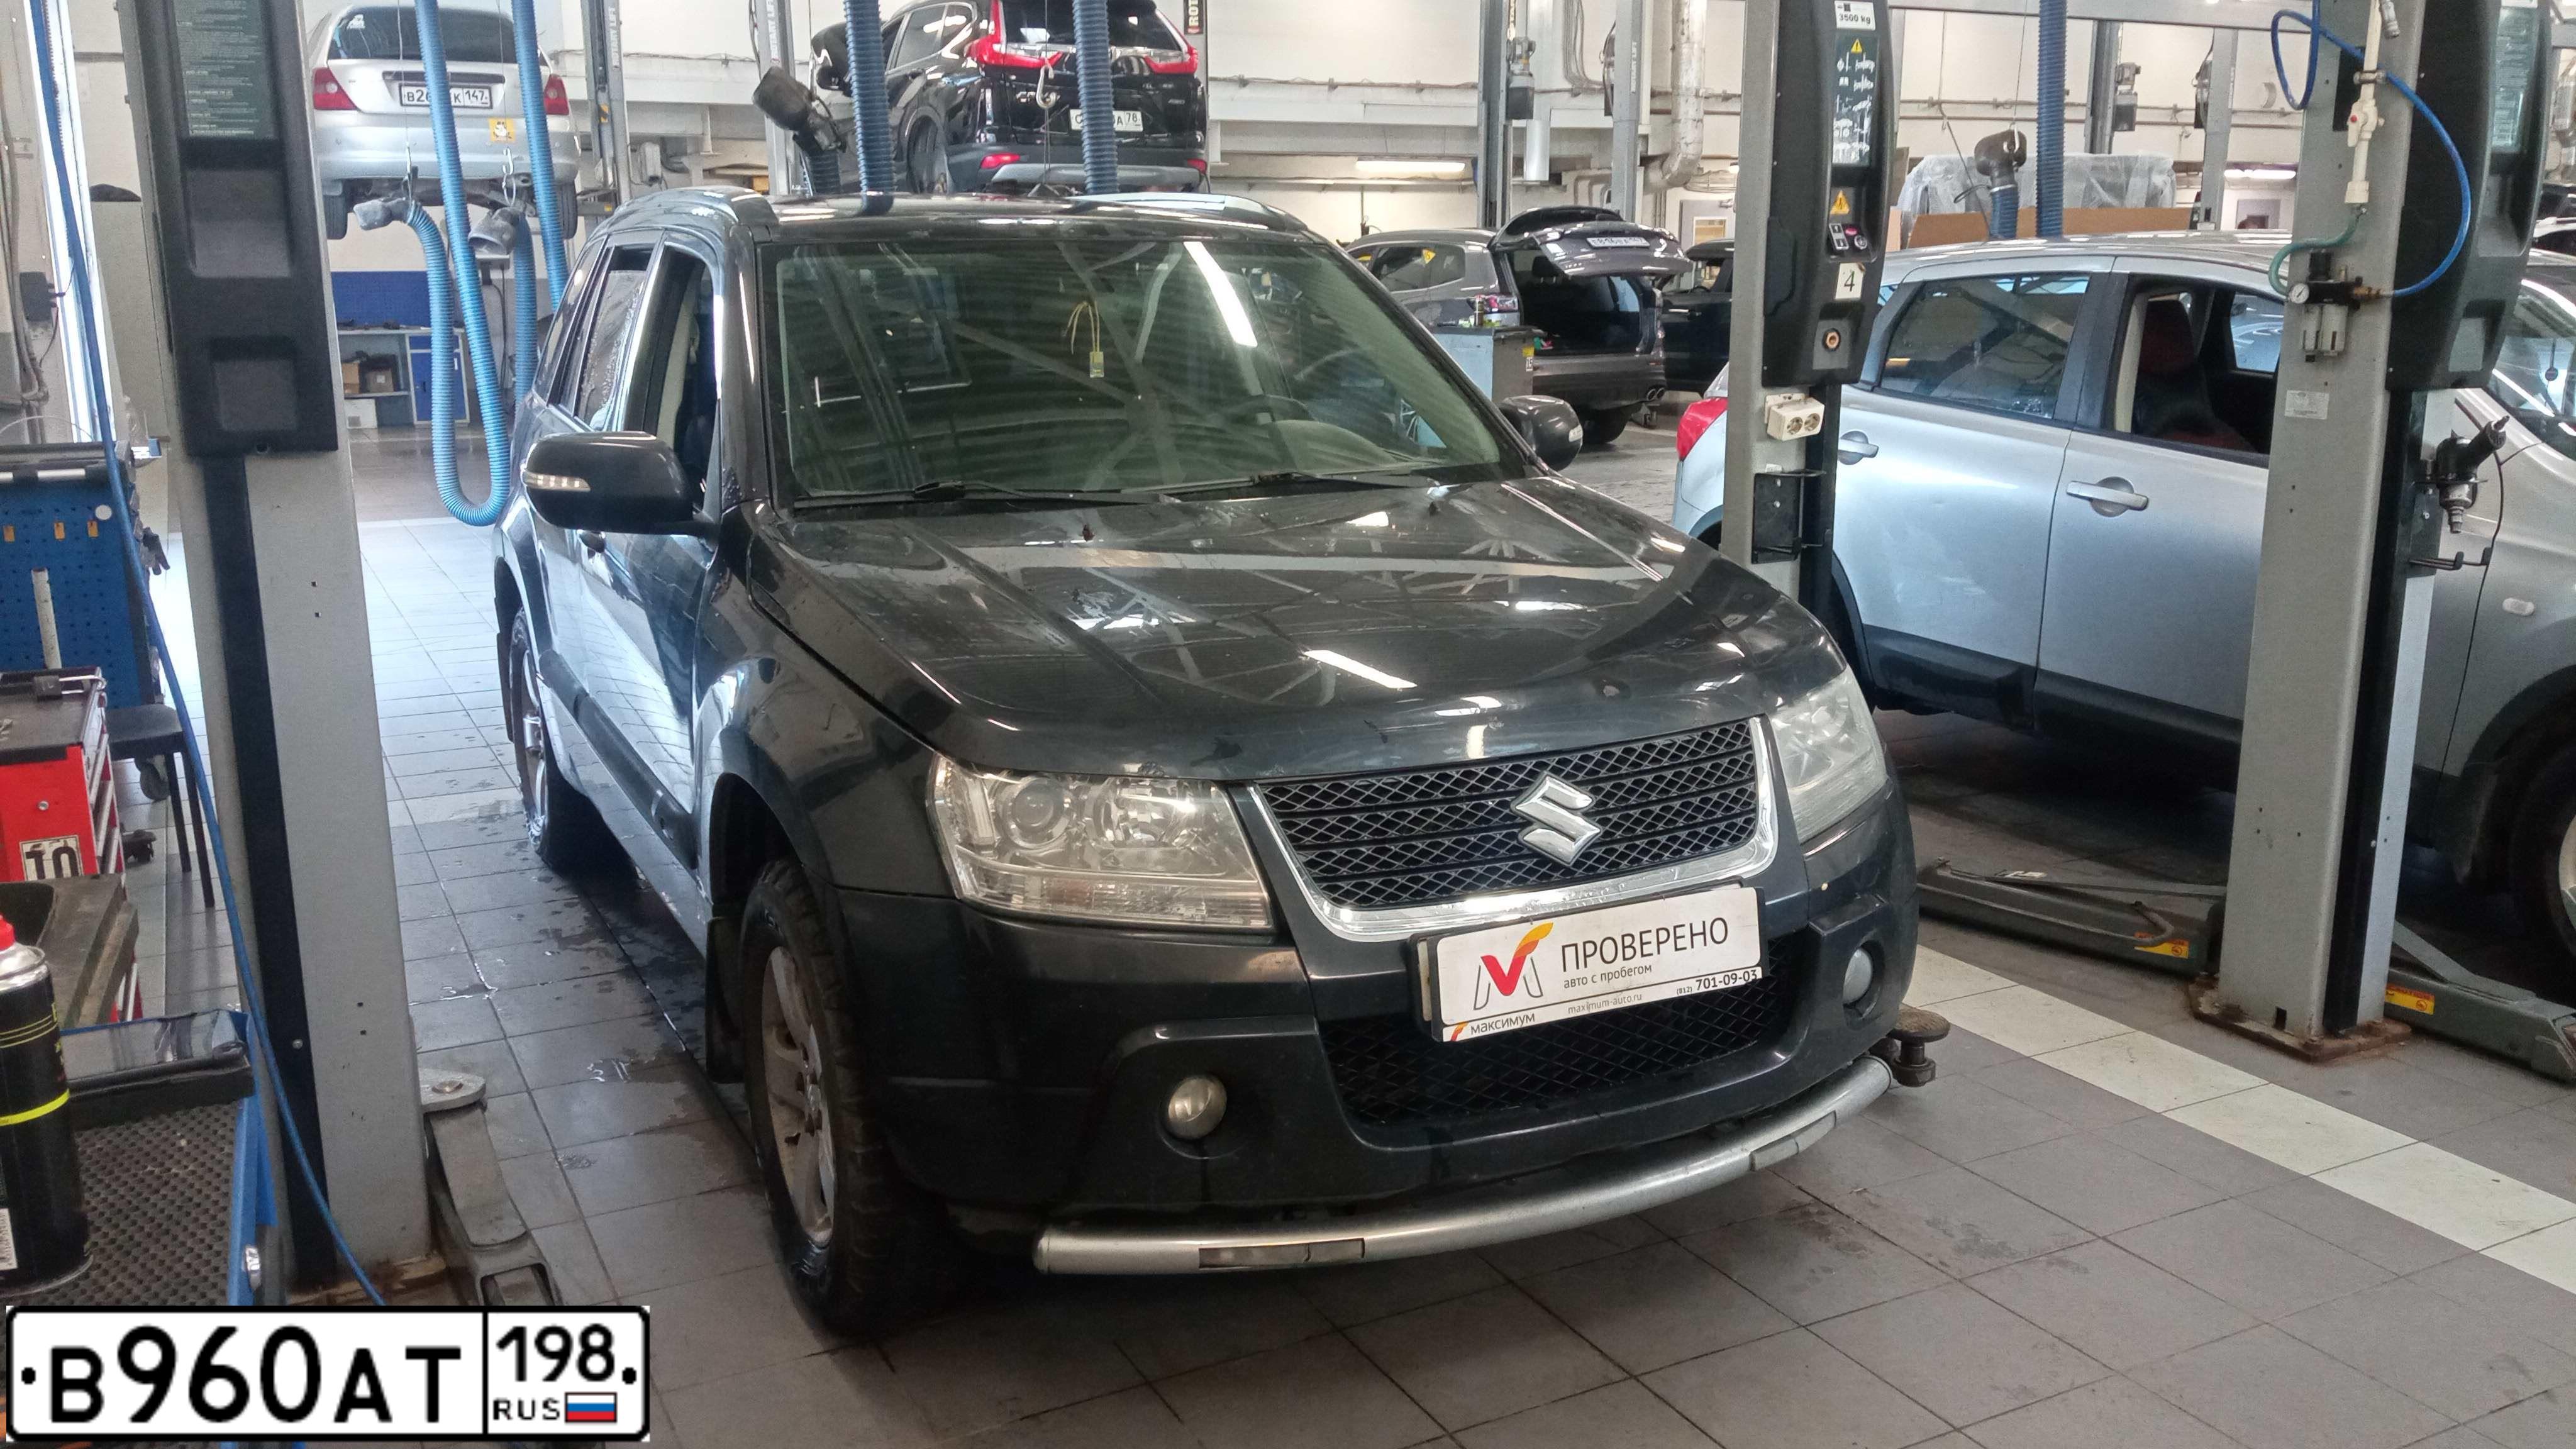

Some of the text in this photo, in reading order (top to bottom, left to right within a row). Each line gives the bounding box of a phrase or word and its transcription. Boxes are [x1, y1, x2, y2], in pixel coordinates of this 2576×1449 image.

[1840, 14, 1858, 22] 3500
[465, 90, 484, 101] 147
[1126, 112, 1138, 123] 78
[1844, 270, 1855, 292] 4
[1561, 917, 1728, 972] ПРОВЕРЕНО
[1563, 964, 1652, 989] авто с пробегом
[1676, 969, 1758, 996] (812) 701-09-03
[1567, 993, 1642, 1014] maximum-auto.ru
[1470, 1013, 1536, 1035] максимум
